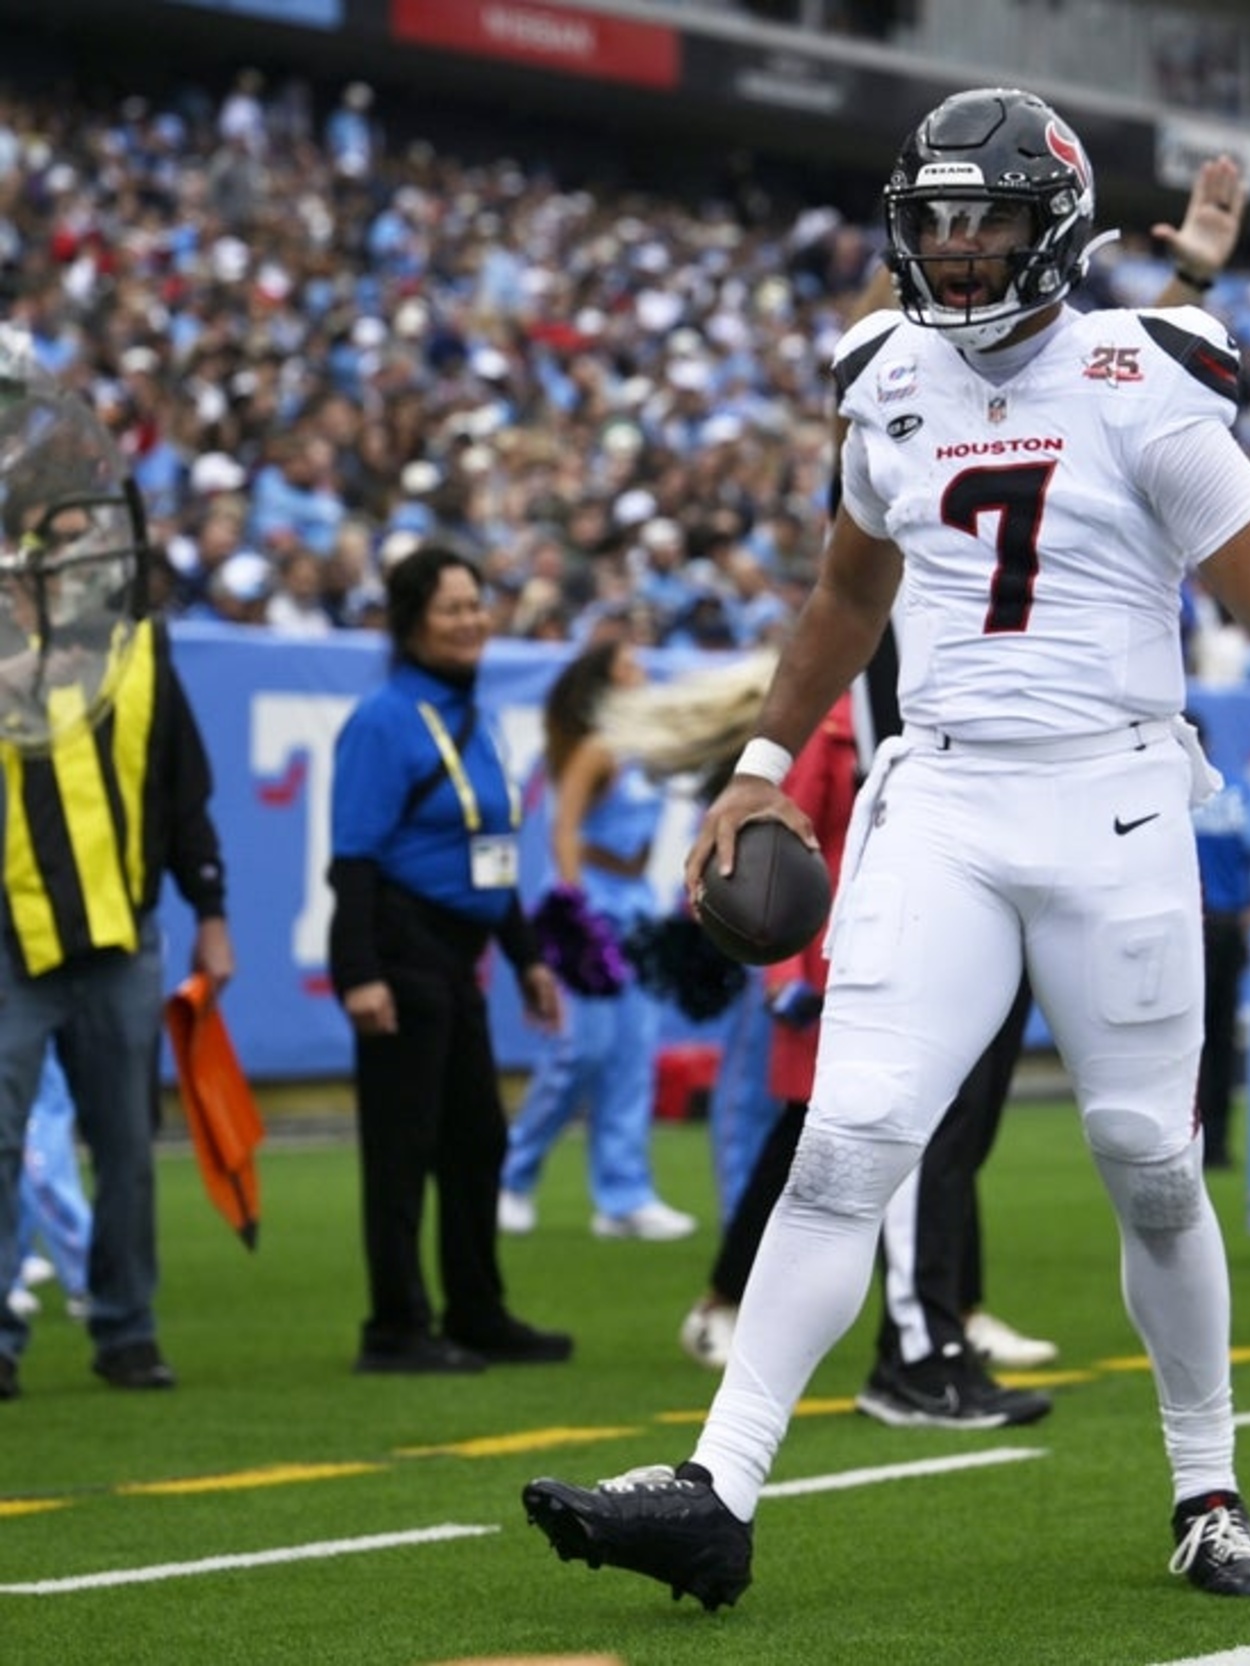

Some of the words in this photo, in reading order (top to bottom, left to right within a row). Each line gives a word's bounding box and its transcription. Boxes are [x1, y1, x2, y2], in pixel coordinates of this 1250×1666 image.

[1091, 347, 1141, 374] 25
[936, 438, 1063, 460] HOUSTON
[941, 460, 1058, 635] 7
